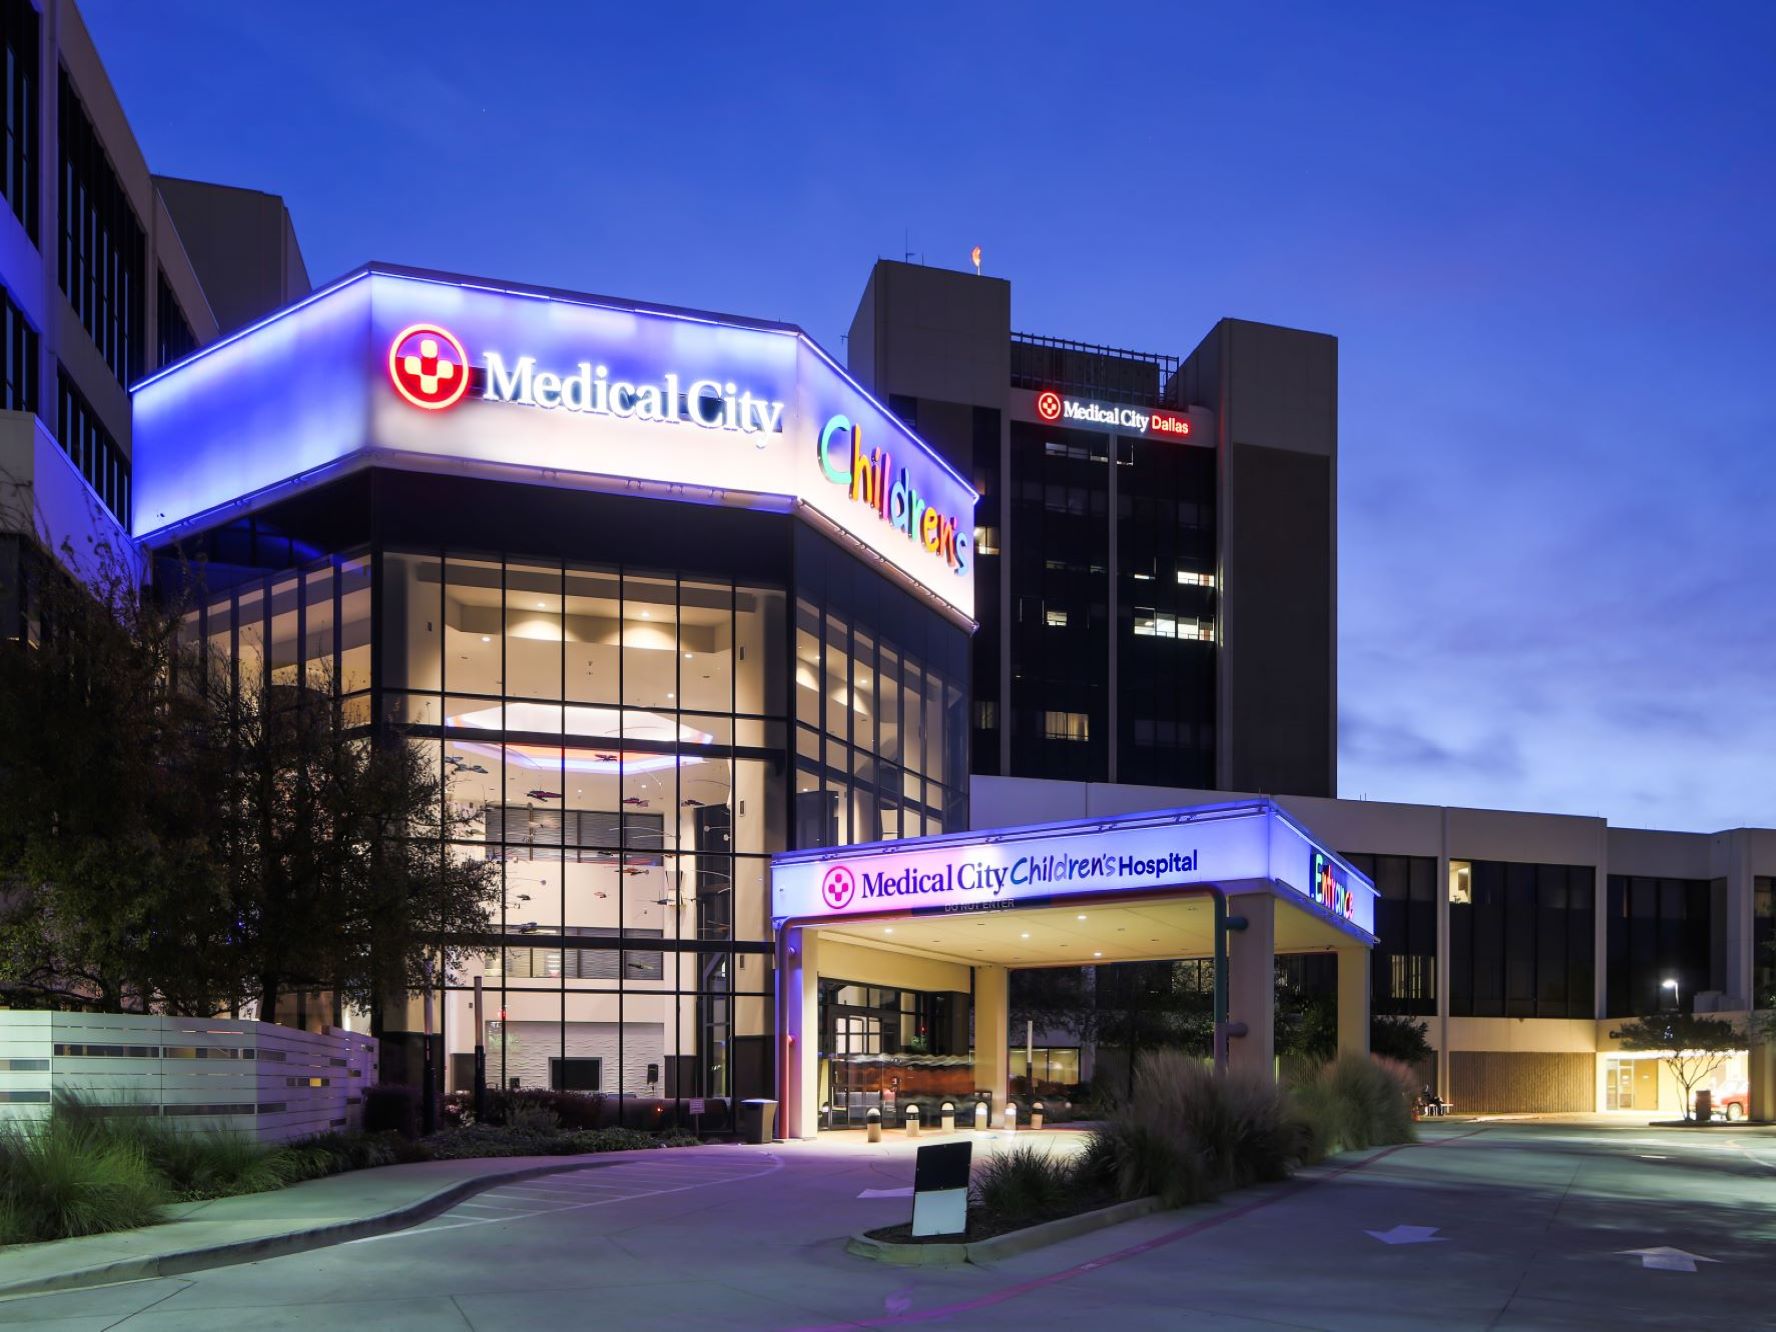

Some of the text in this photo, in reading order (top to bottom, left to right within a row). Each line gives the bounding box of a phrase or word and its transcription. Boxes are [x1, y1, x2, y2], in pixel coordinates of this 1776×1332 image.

[482, 351, 785, 449] Medical City
[1063, 400, 1189, 434] Medical City Dallas
[817, 414, 968, 576] Children's
[861, 848, 1198, 899] Medical City Children's Hospital
[944, 898, 1015, 912] DO NOT ENTER
